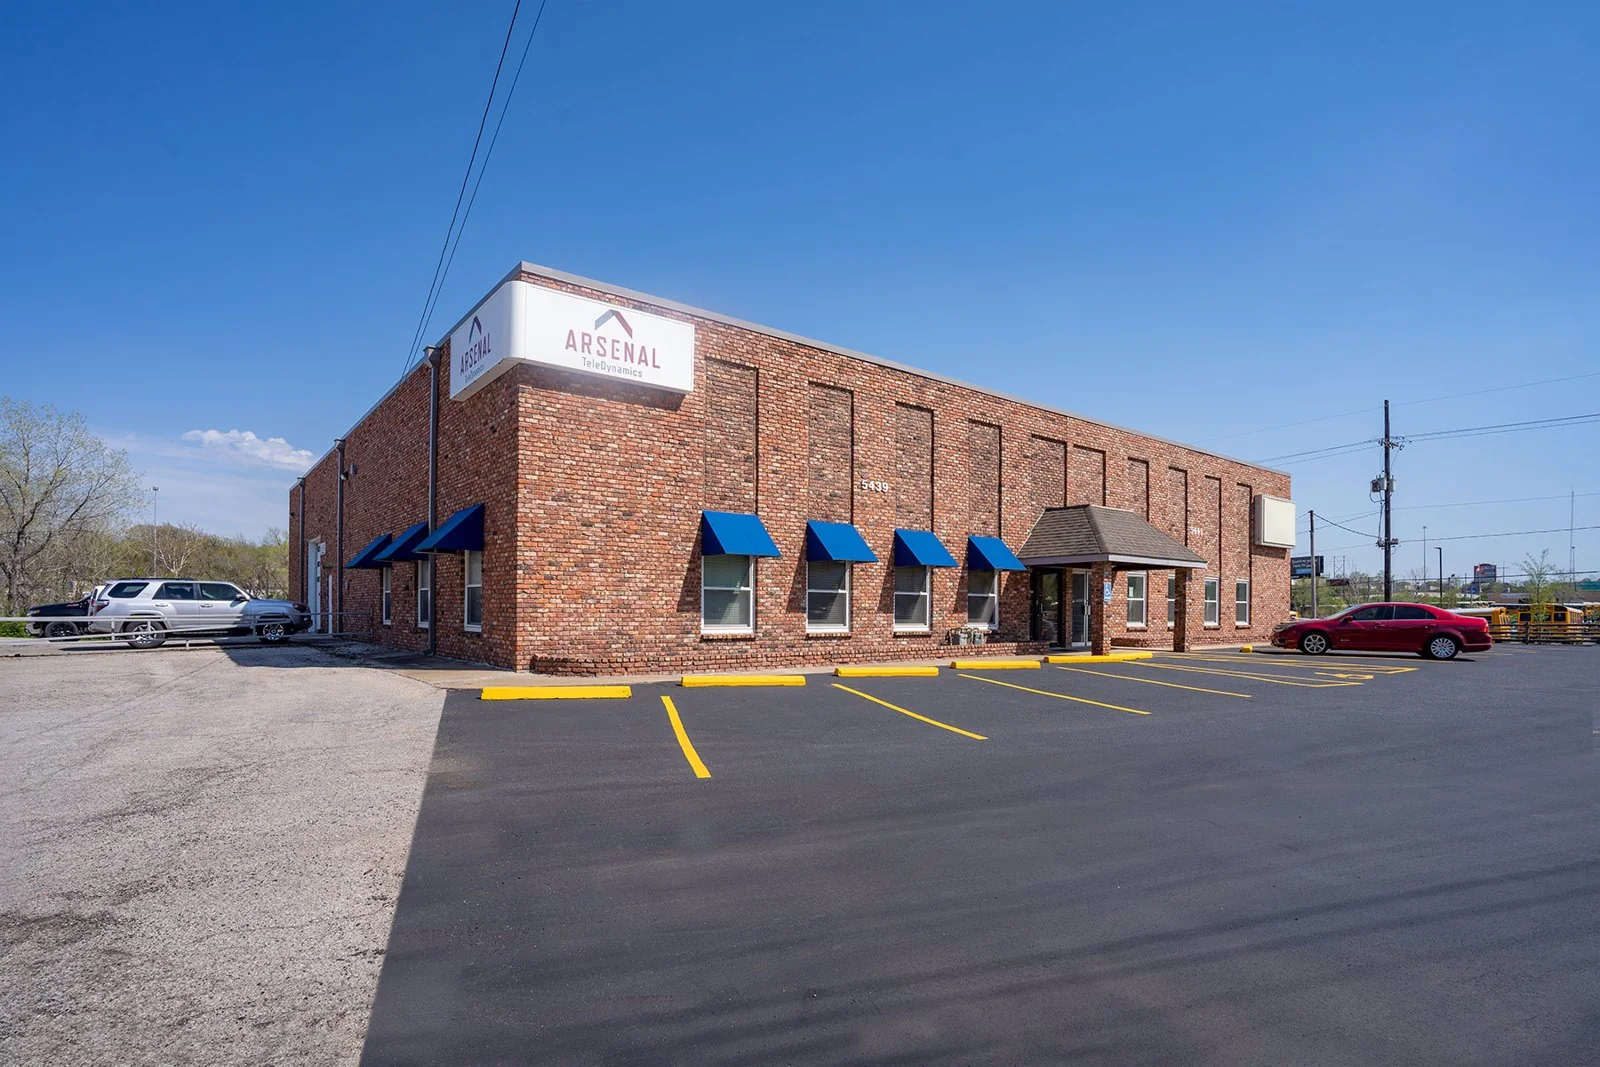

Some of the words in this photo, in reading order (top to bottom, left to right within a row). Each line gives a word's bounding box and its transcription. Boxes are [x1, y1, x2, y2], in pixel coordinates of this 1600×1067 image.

[460, 333, 491, 376] ARSENAL
[565, 329, 661, 369] ARSENAL
[582, 356, 643, 378] TeleDynamics
[861, 479, 889, 493] 5439
